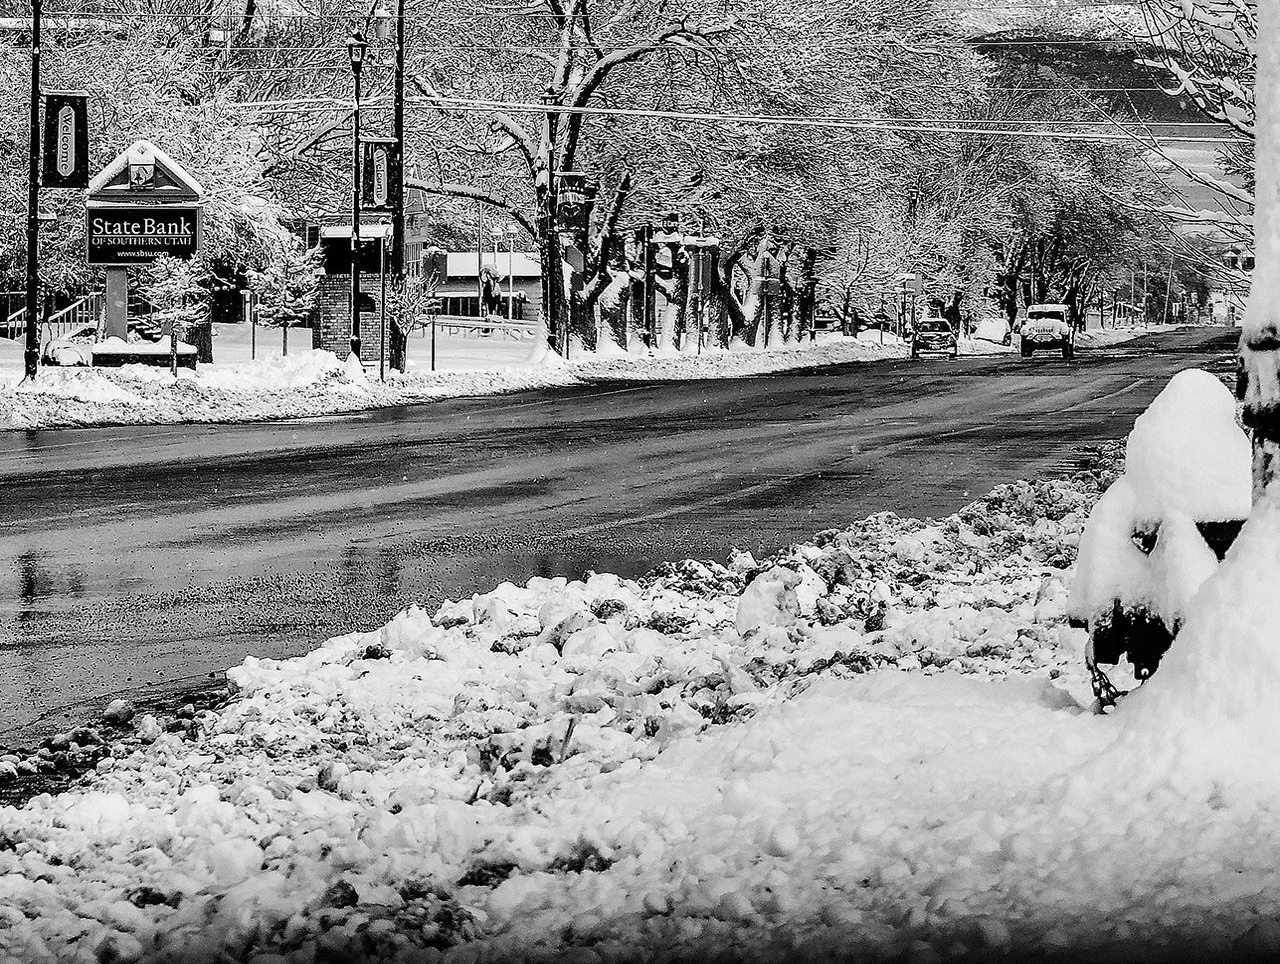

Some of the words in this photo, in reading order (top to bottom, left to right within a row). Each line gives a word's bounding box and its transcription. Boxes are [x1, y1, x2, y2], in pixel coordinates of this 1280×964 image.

[61, 112, 73, 171] Welcome
[376, 153, 386, 199] Welcome
[92, 217, 141, 235] State
[91, 237, 106, 245] OF
[107, 237, 162, 246] SOUTHERN
[164, 237, 192, 245] UTAH
[116, 249, 170, 257] www.sbsu.com
